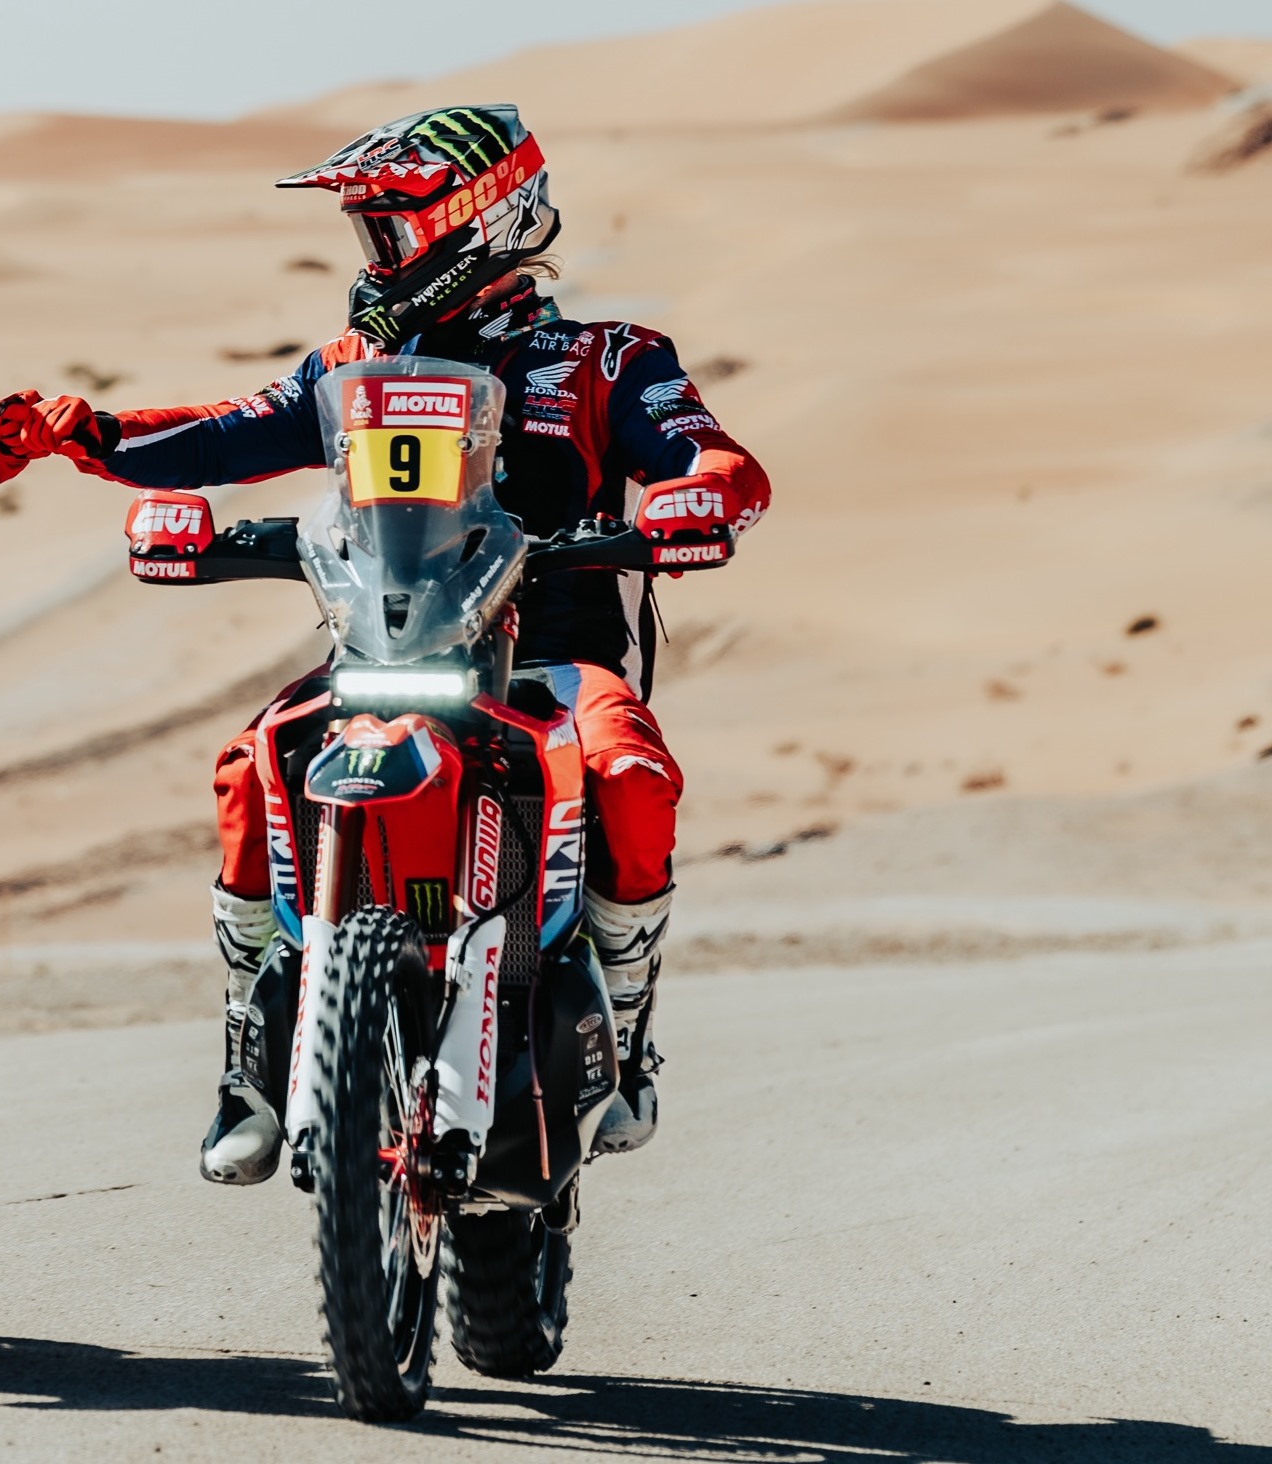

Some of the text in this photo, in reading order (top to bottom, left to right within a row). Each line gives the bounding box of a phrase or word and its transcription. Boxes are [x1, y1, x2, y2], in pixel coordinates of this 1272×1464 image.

[428, 153, 525, 238] 100%
[411, 254, 477, 307] MONSTER
[430, 268, 474, 307] ENERGY
[529, 339, 590, 356] AIR BAG
[387, 395, 460, 414] MOTUL
[524, 386, 579, 400] HONDA
[524, 420, 570, 436] MOTUL
[389, 434, 421, 492] 9
[131, 504, 203, 535] GIVI
[644, 489, 724, 520] GIVI
[133, 560, 190, 577] MOTUL
[659, 545, 723, 563] MOTUL
[472, 795, 503, 911] SHOWA
[544, 797, 585, 895] CRF
[477, 946, 499, 1110] HONDA
